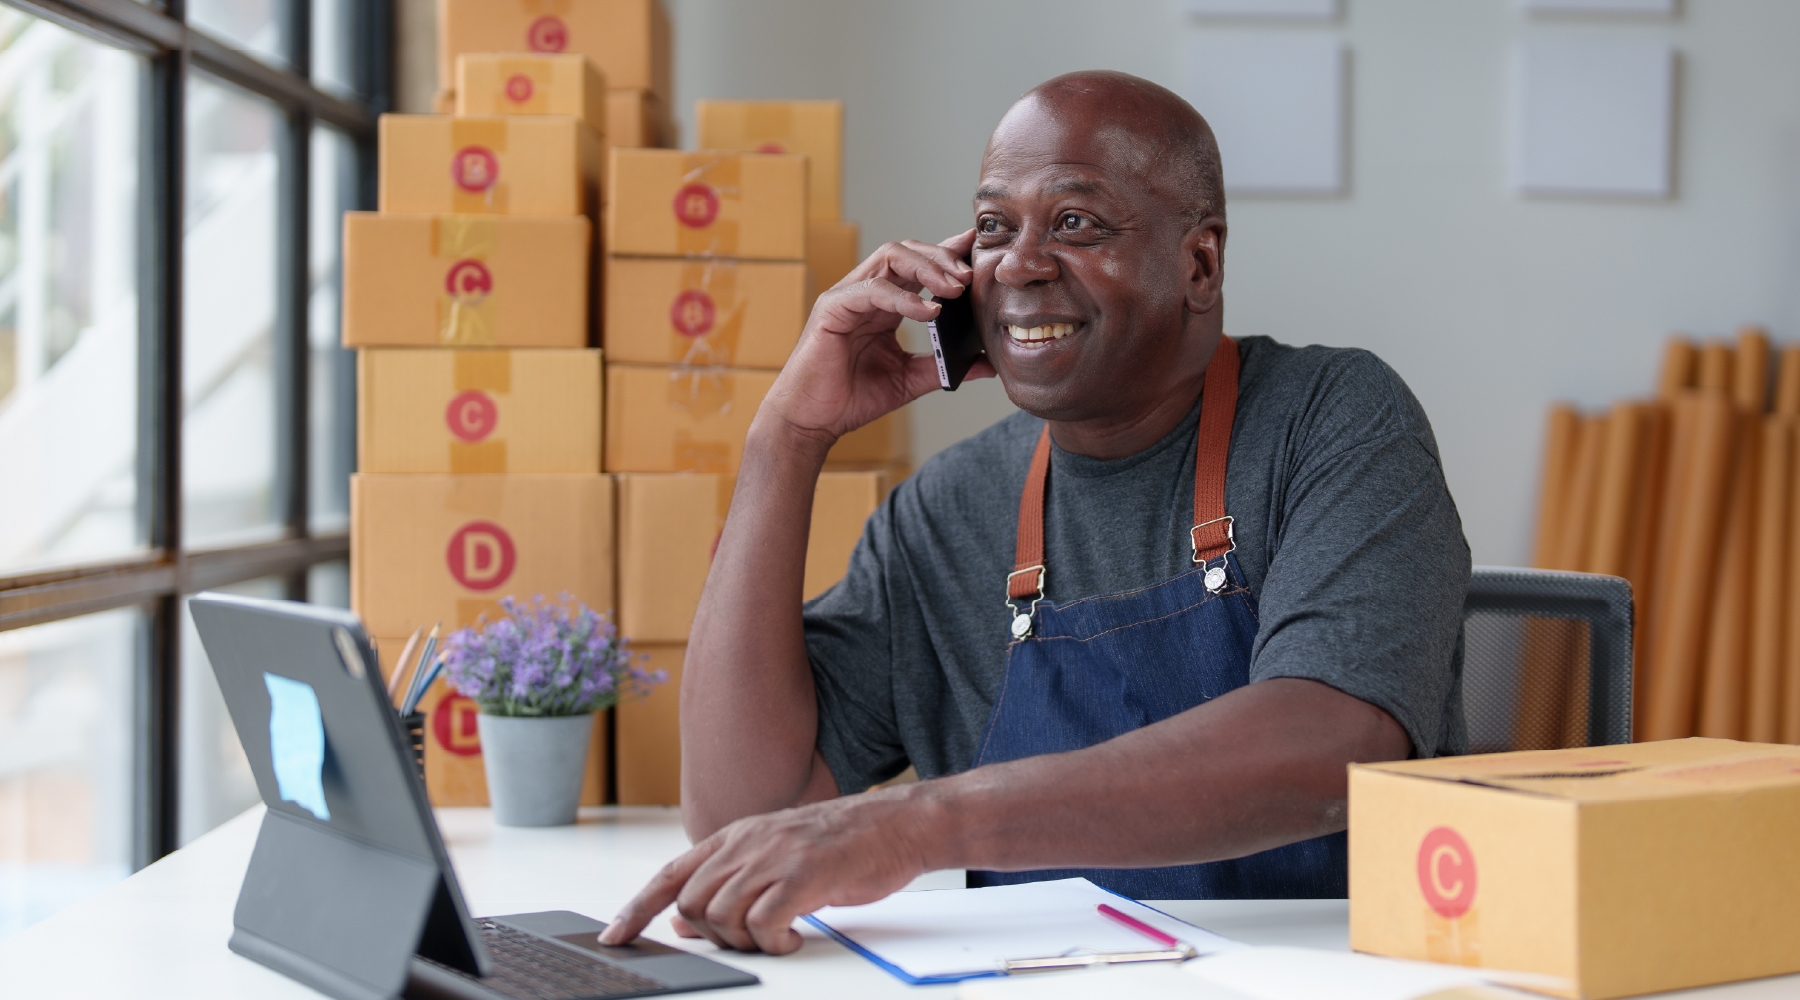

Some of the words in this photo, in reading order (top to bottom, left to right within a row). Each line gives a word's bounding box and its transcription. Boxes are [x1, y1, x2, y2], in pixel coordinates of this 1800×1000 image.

[463, 154, 486, 185] B
[454, 264, 484, 299] C
[460, 400, 483, 432] C
[464, 533, 503, 580] D
[451, 700, 480, 747] D
[1430, 844, 1464, 900] C
